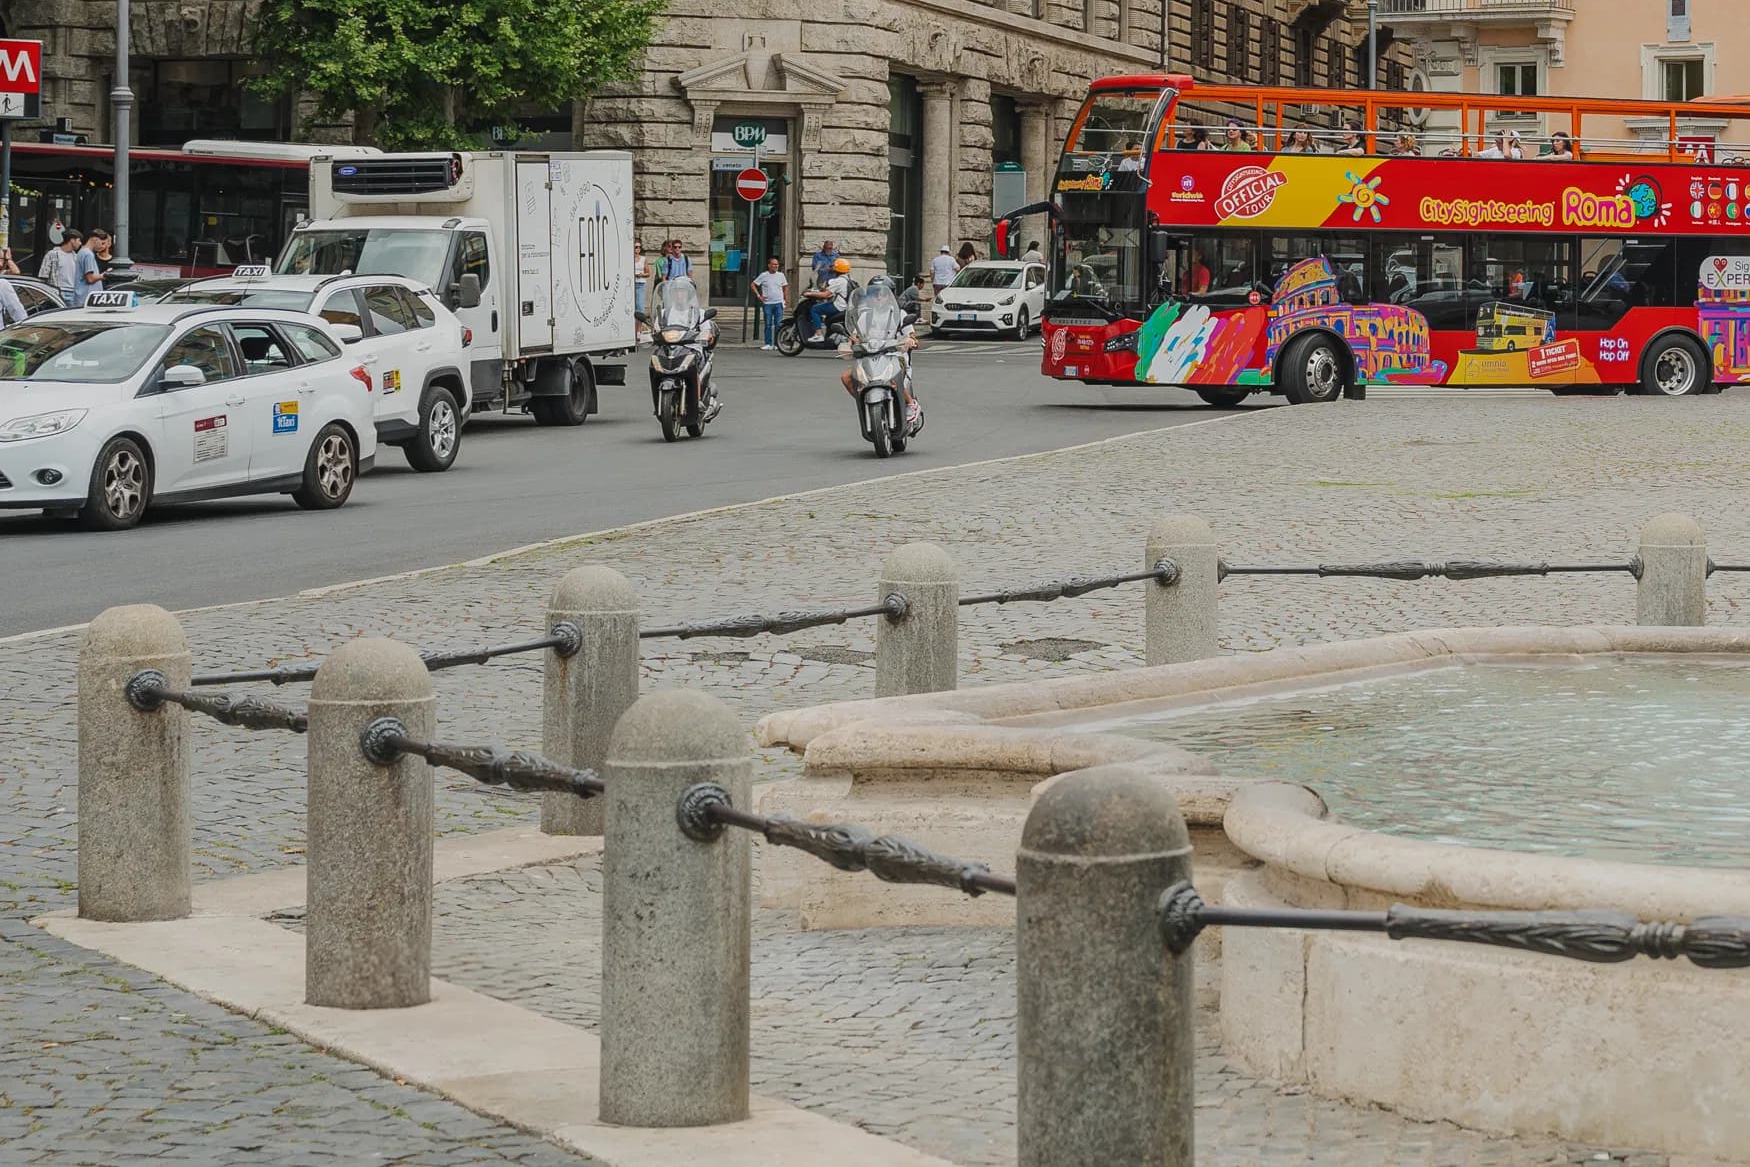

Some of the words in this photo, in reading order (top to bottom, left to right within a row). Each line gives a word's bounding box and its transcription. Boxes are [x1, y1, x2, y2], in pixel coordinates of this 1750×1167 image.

[735, 126, 766, 141] BPM
[1222, 173, 1285, 213] OFFICIAL
[1244, 194, 1273, 215] TOUR
[1562, 186, 1636, 228] Roma
[236, 266, 265, 276] TAXI
[92, 292, 124, 305] TAXI
[1600, 338, 1616, 350] Hop
[1617, 337, 1629, 349] On
[1546, 345, 1567, 356] TICKET
[1600, 350, 1616, 362] Hop
[1617, 350, 1630, 362] Off
